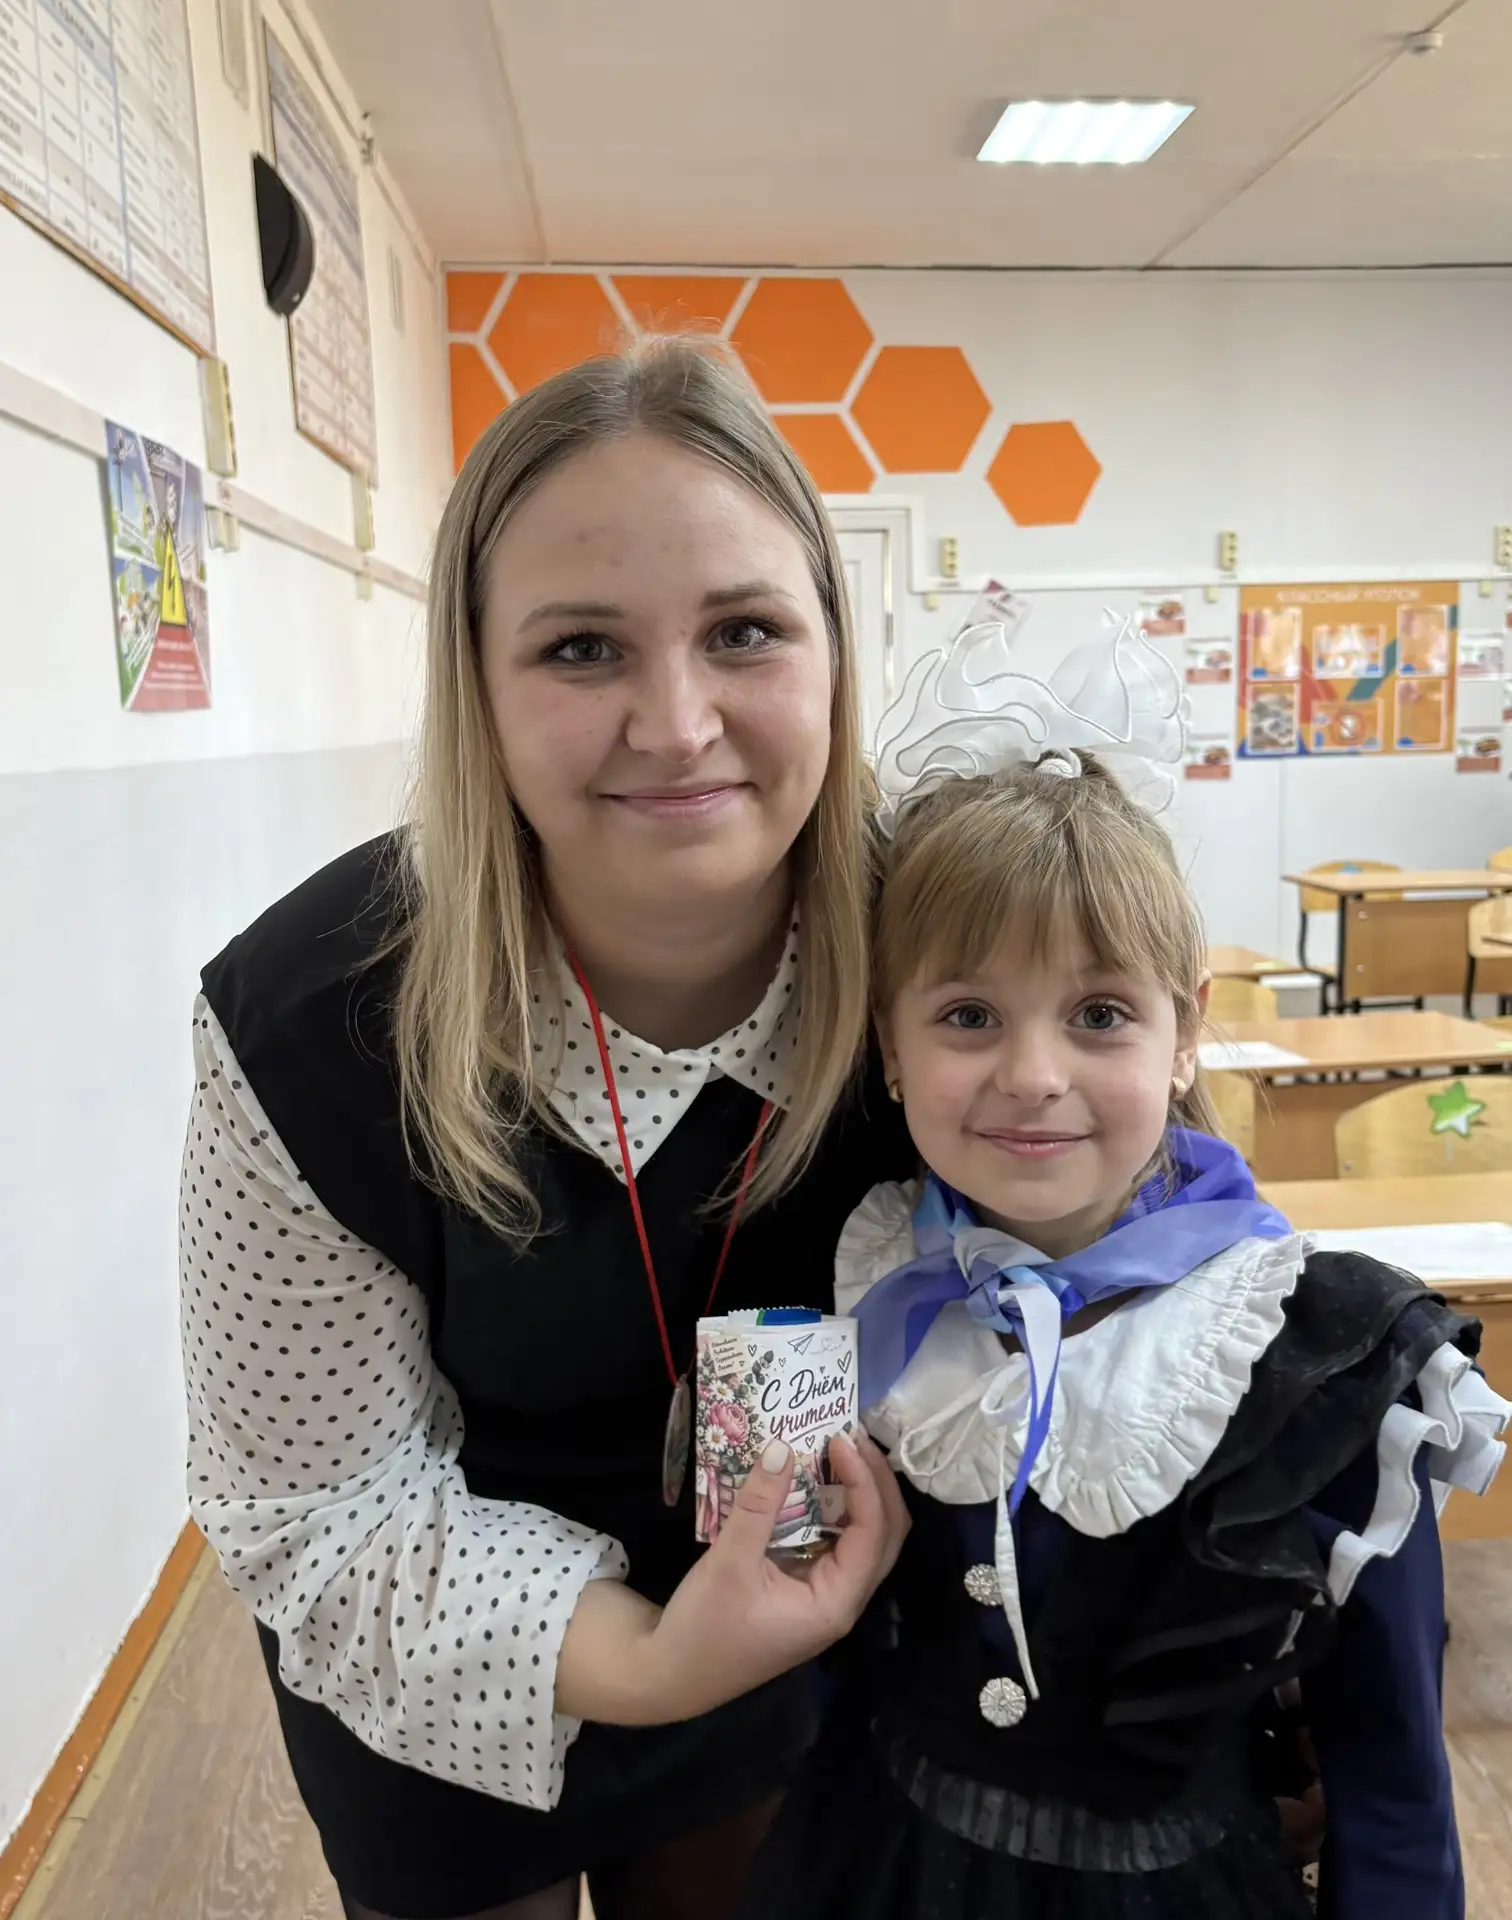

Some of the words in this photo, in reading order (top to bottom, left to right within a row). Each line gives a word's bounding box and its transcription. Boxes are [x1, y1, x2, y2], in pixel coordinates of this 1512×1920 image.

[761, 1378, 782, 1412] С
[788, 1368, 846, 1409] Днём
[769, 1382, 855, 1440] учителя!
